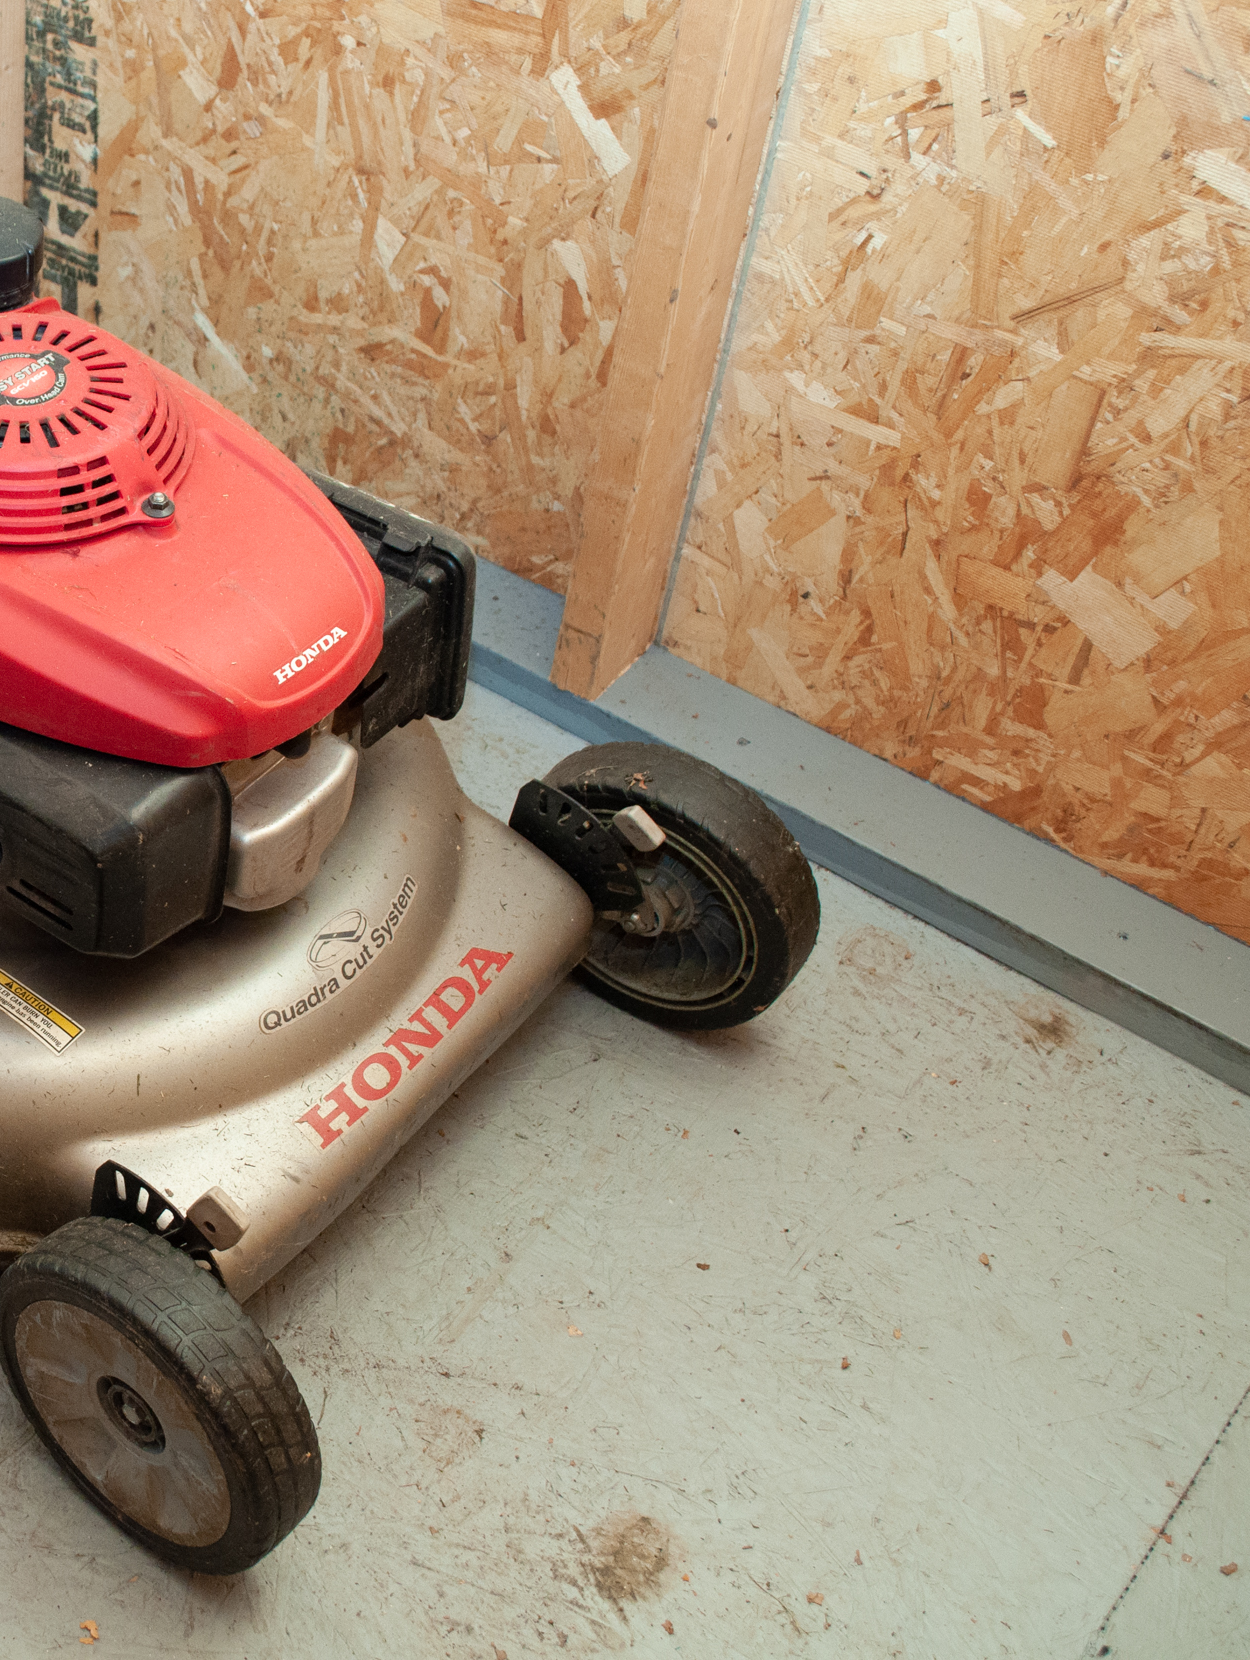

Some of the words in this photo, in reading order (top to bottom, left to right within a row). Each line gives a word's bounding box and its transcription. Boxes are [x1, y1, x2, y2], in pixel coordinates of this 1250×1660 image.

[14, 353, 55, 380] START
[16, 397, 41, 405] Over
[41, 388, 61, 401] Head
[55, 373, 65, 387] Cam
[273, 626, 347, 685] HONDA
[262, 977, 340, 1031] Quadra
[341, 944, 374, 980] Cut
[370, 875, 416, 949] System
[10, 996, 23, 1006] CAN
[22, 1005, 40, 1018] BURN
[14, 987, 53, 1015] CAUTION
[15, 1009, 26, 1018] has
[26, 1016, 41, 1029] been
[295, 947, 514, 1149] HONDA
